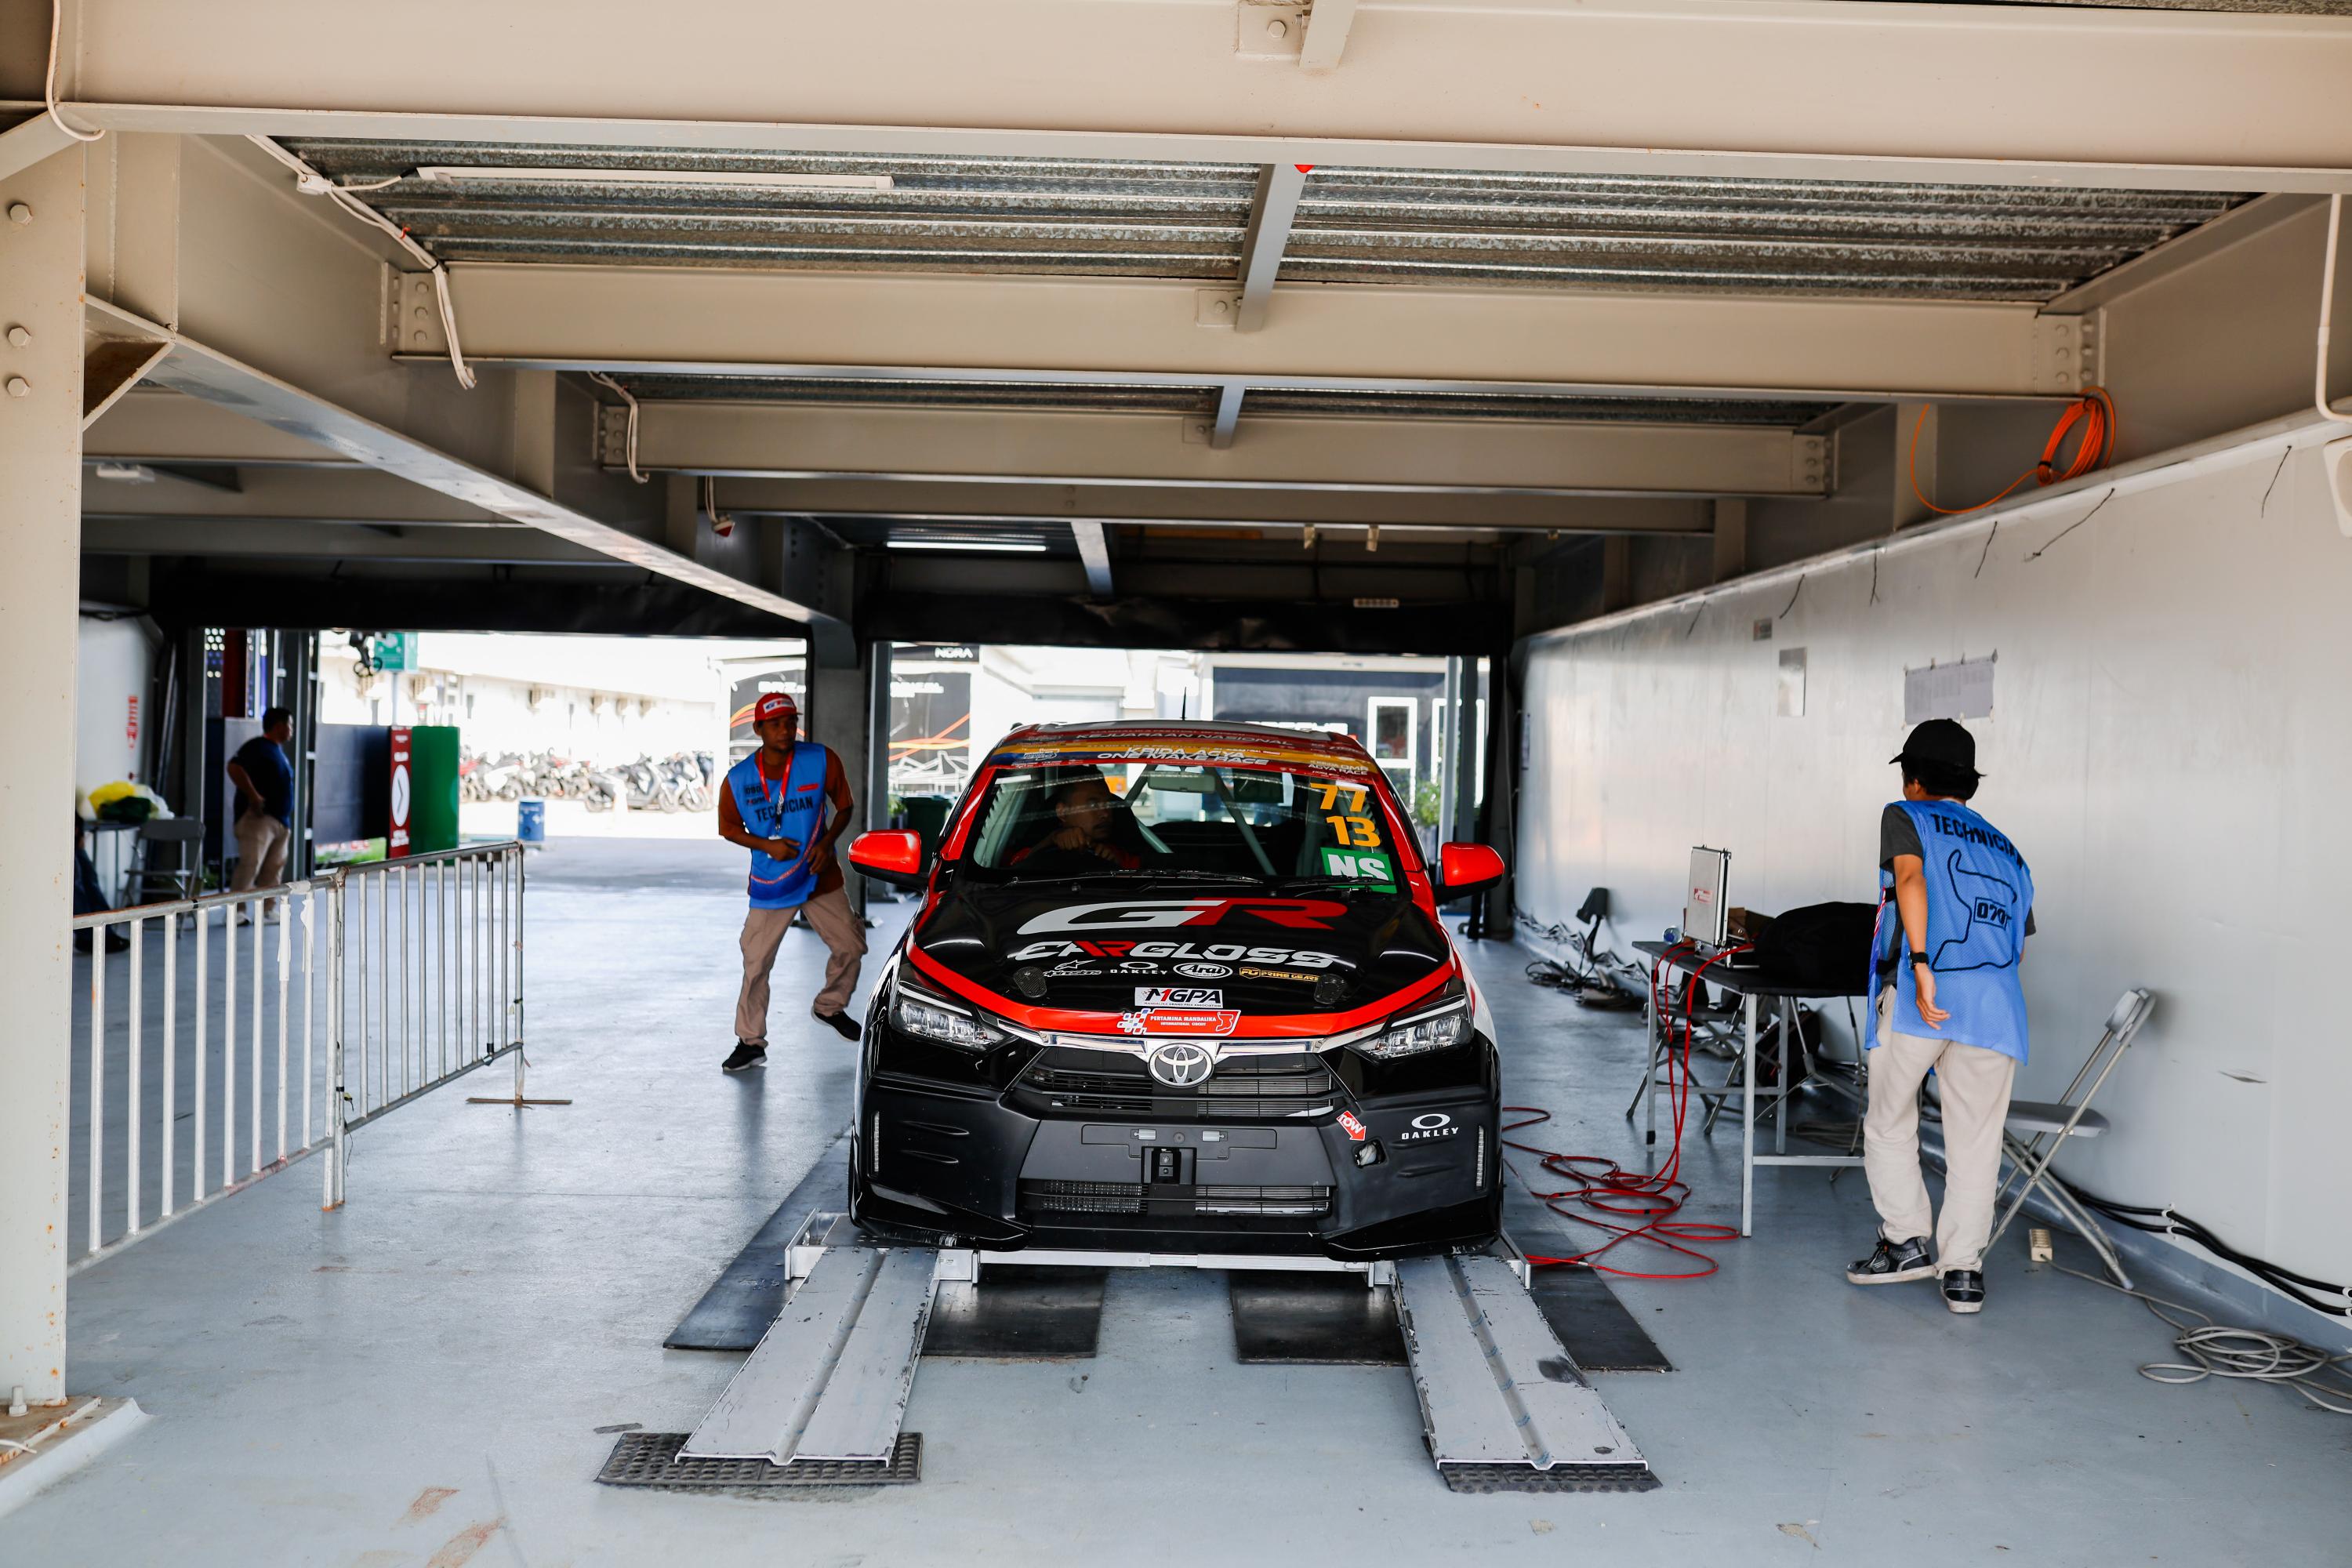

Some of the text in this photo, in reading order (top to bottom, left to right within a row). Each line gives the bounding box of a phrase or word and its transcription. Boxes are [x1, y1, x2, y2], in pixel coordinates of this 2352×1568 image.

[1214, 756, 1269, 765] RACE
[1310, 782, 1367, 812] 77
[1327, 815, 1381, 848] 13
[1931, 813, 2024, 869] TECHNICIAN
[1327, 854, 1389, 881] NS
[1017, 897, 1348, 935] GR
[1015, 941, 1339, 968] CARGLOSS
[1180, 964, 1225, 975] Arai
[1338, 1114, 1363, 1134] TOW
[1401, 1127, 1459, 1140] OAKLEY
